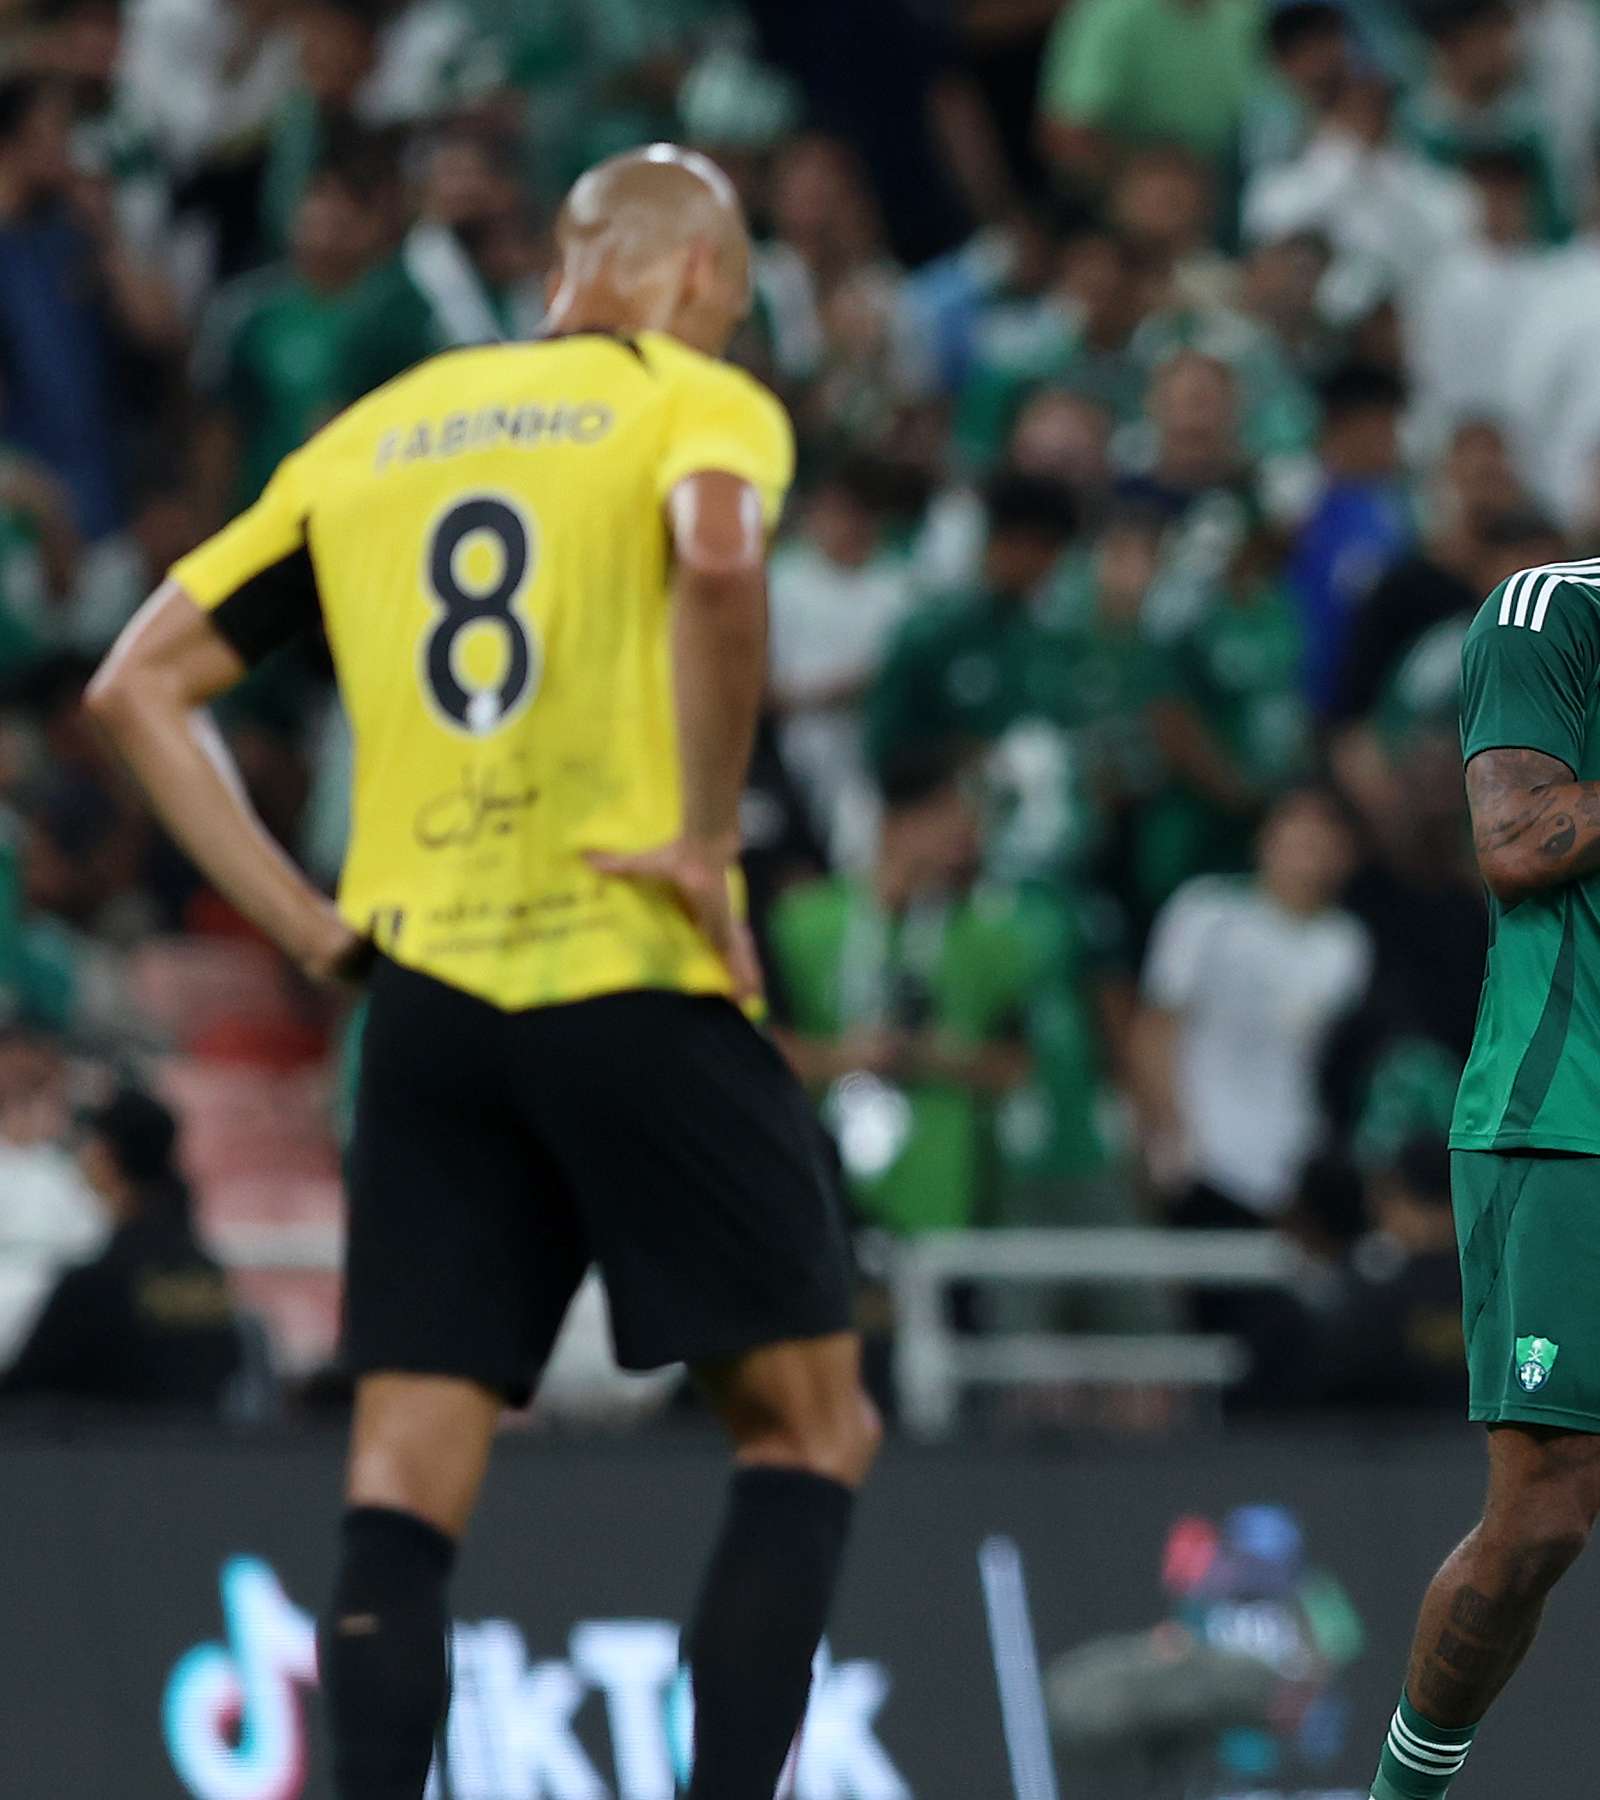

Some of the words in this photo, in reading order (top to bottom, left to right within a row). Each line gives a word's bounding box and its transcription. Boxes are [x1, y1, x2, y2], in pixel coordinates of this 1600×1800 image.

[373, 400, 613, 476] FABINHO
[421, 488, 537, 738] 8
[422, 1617, 914, 1800] ikTk
